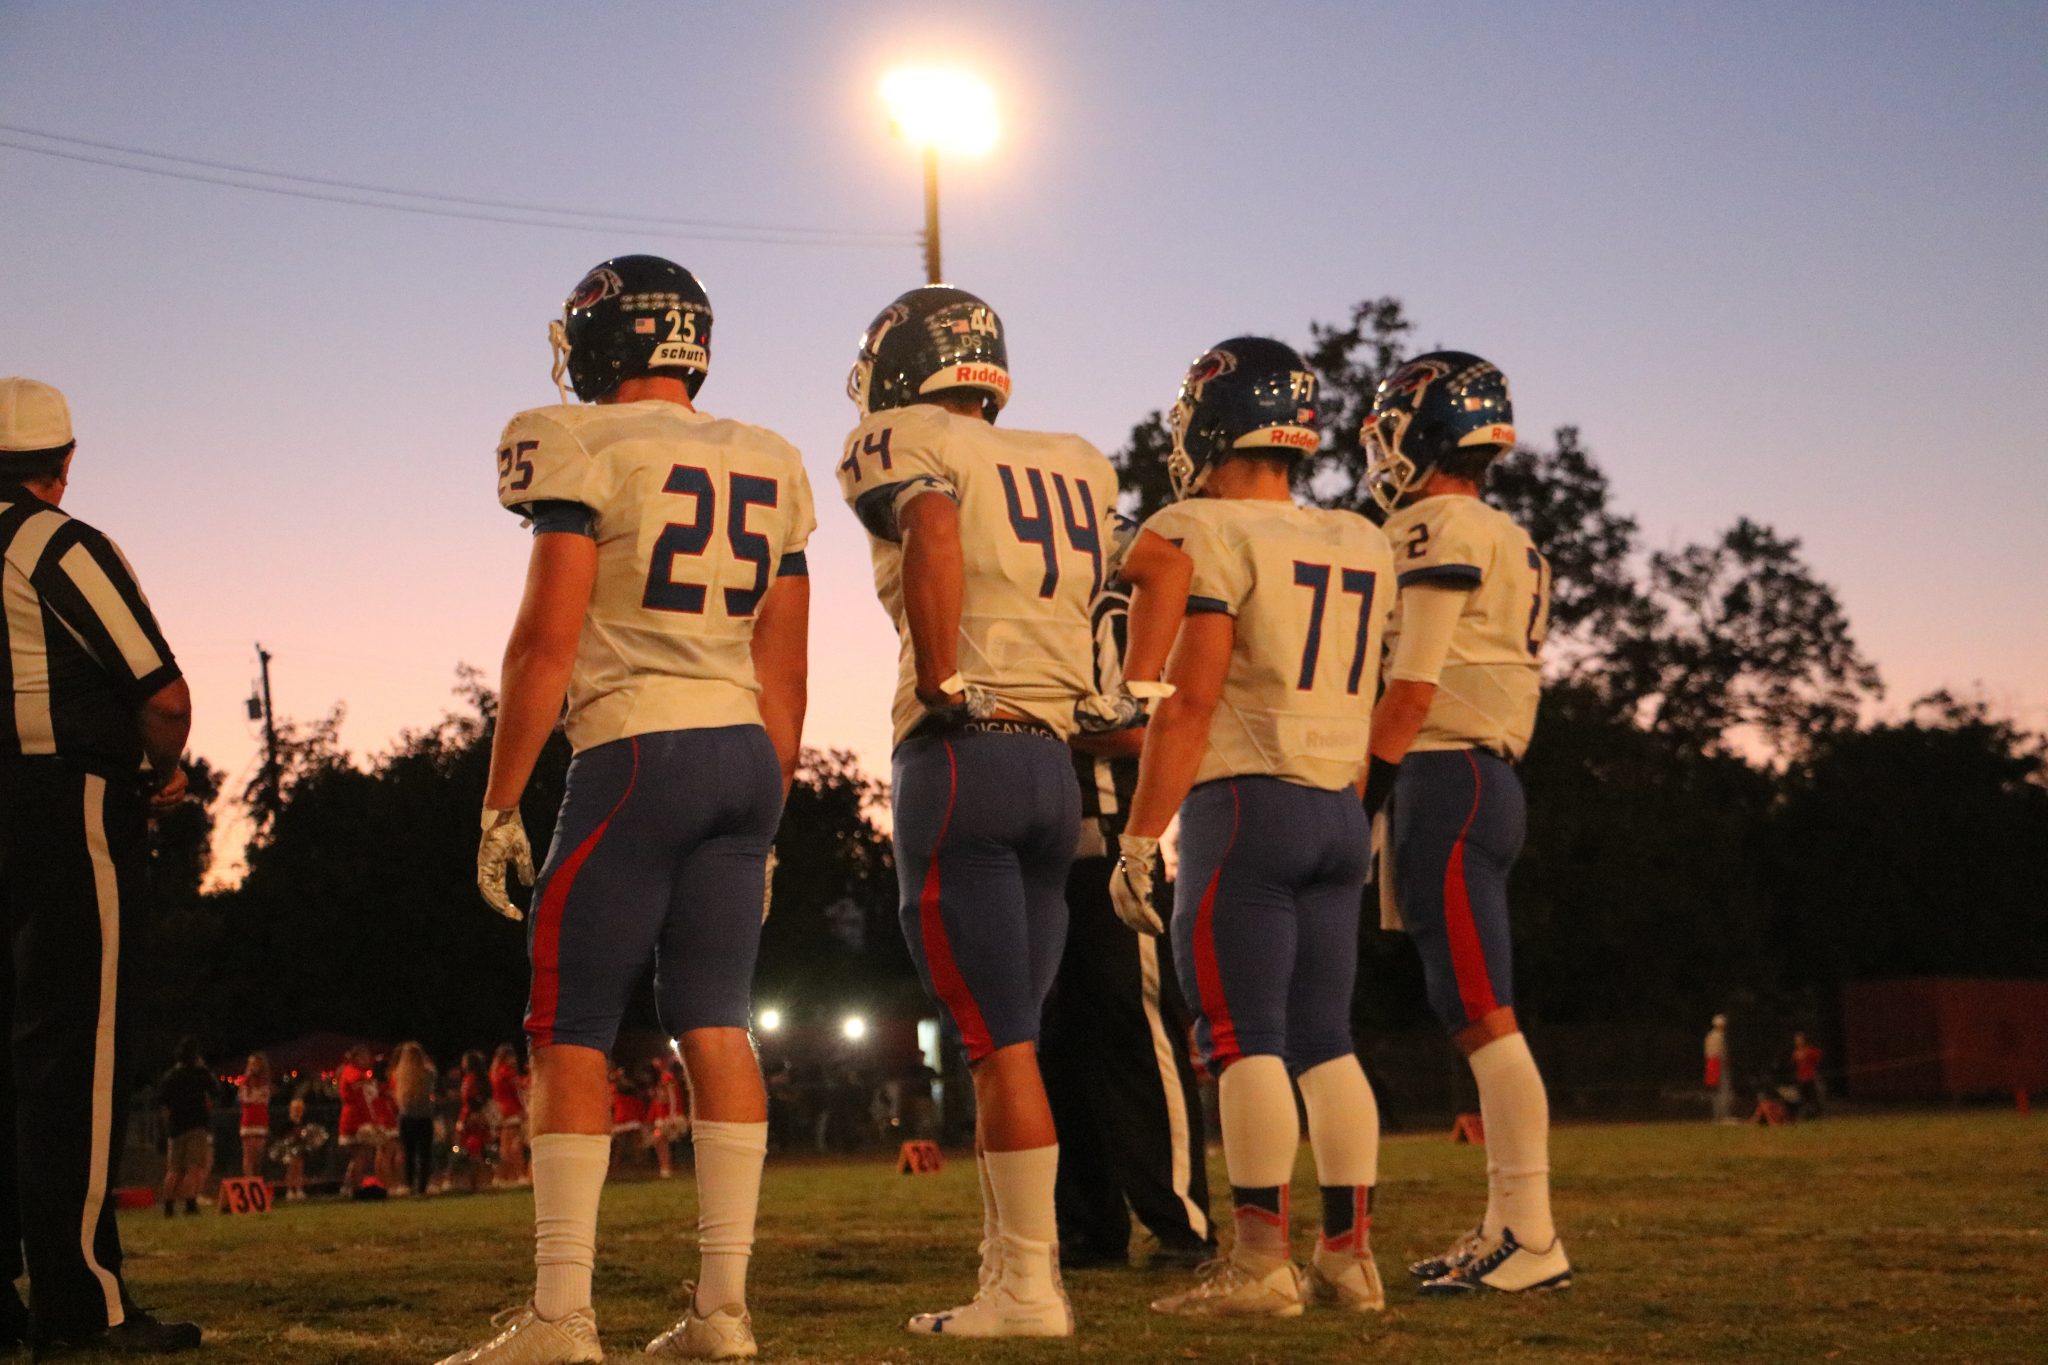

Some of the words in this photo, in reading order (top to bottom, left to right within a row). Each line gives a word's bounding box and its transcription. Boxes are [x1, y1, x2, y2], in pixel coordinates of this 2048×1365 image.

[664, 309, 696, 343] 25
[971, 308, 998, 339] 44
[1289, 370, 1315, 402] 77
[642, 464, 778, 617] 25
[996, 463, 1102, 608] 44
[1408, 523, 1429, 559] 2
[1292, 560, 1376, 695] 77
[231, 1182, 266, 1212] 30
